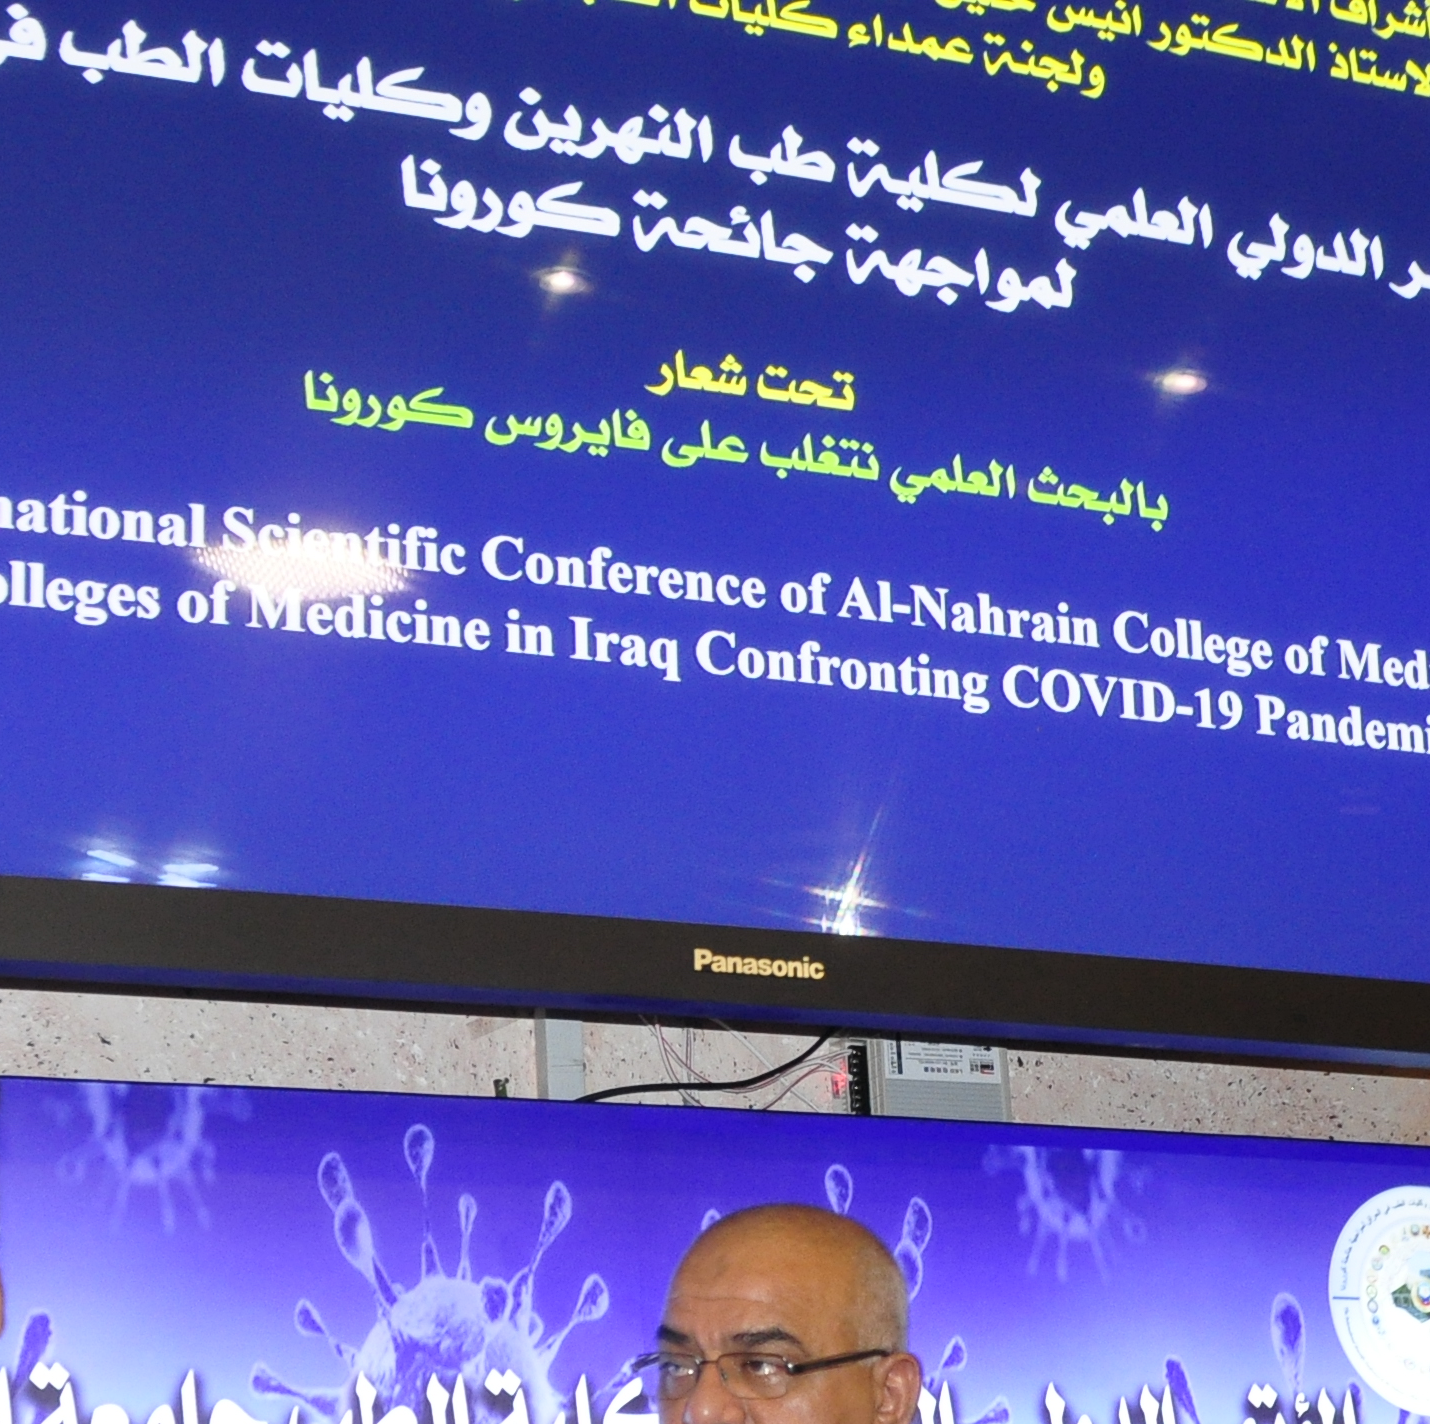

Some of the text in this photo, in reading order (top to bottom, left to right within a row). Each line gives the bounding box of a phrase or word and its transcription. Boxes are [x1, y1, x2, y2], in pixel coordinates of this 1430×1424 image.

[59, 20, 225, 85] الطب
[847, 13, 975, 64] عمداء
[1046, 0, 1142, 42] انيس
[1151, 13, 1316, 74] الدكتور
[242, 43, 491, 137] وكليات
[983, 31, 1106, 98] ولجنة
[504, 86, 713, 164] النهرين
[728, 125, 834, 186] طب
[847, 137, 1041, 218] لكلية
[402, 156, 1076, 315] لمواجهة جائحة كورونا
[1055, 187, 1213, 253] العلمي
[1227, 215, 1383, 281] الدولي
[646, 349, 855, 412] تحت شعار
[304, 369, 1170, 532] بالبحث العلمي نتغلب على فايروس كورونا
[222, 505, 466, 577] Scientific
[482, 533, 767, 610] Conference
[780, 571, 832, 617] of
[839, 576, 1099, 650] Al-Nahrain
[1114, 609, 1273, 677] College
[1284, 635, 1334, 679] of
[177, 577, 235, 625] of
[244, 591, 489, 653] Medicine
[505, 611, 554, 658] in
[570, 616, 681, 683] Iraq
[695, 630, 991, 714] Confronting
[1002, 663, 1243, 732] COVID-19
[693, 948, 825, 981] Panasonic
